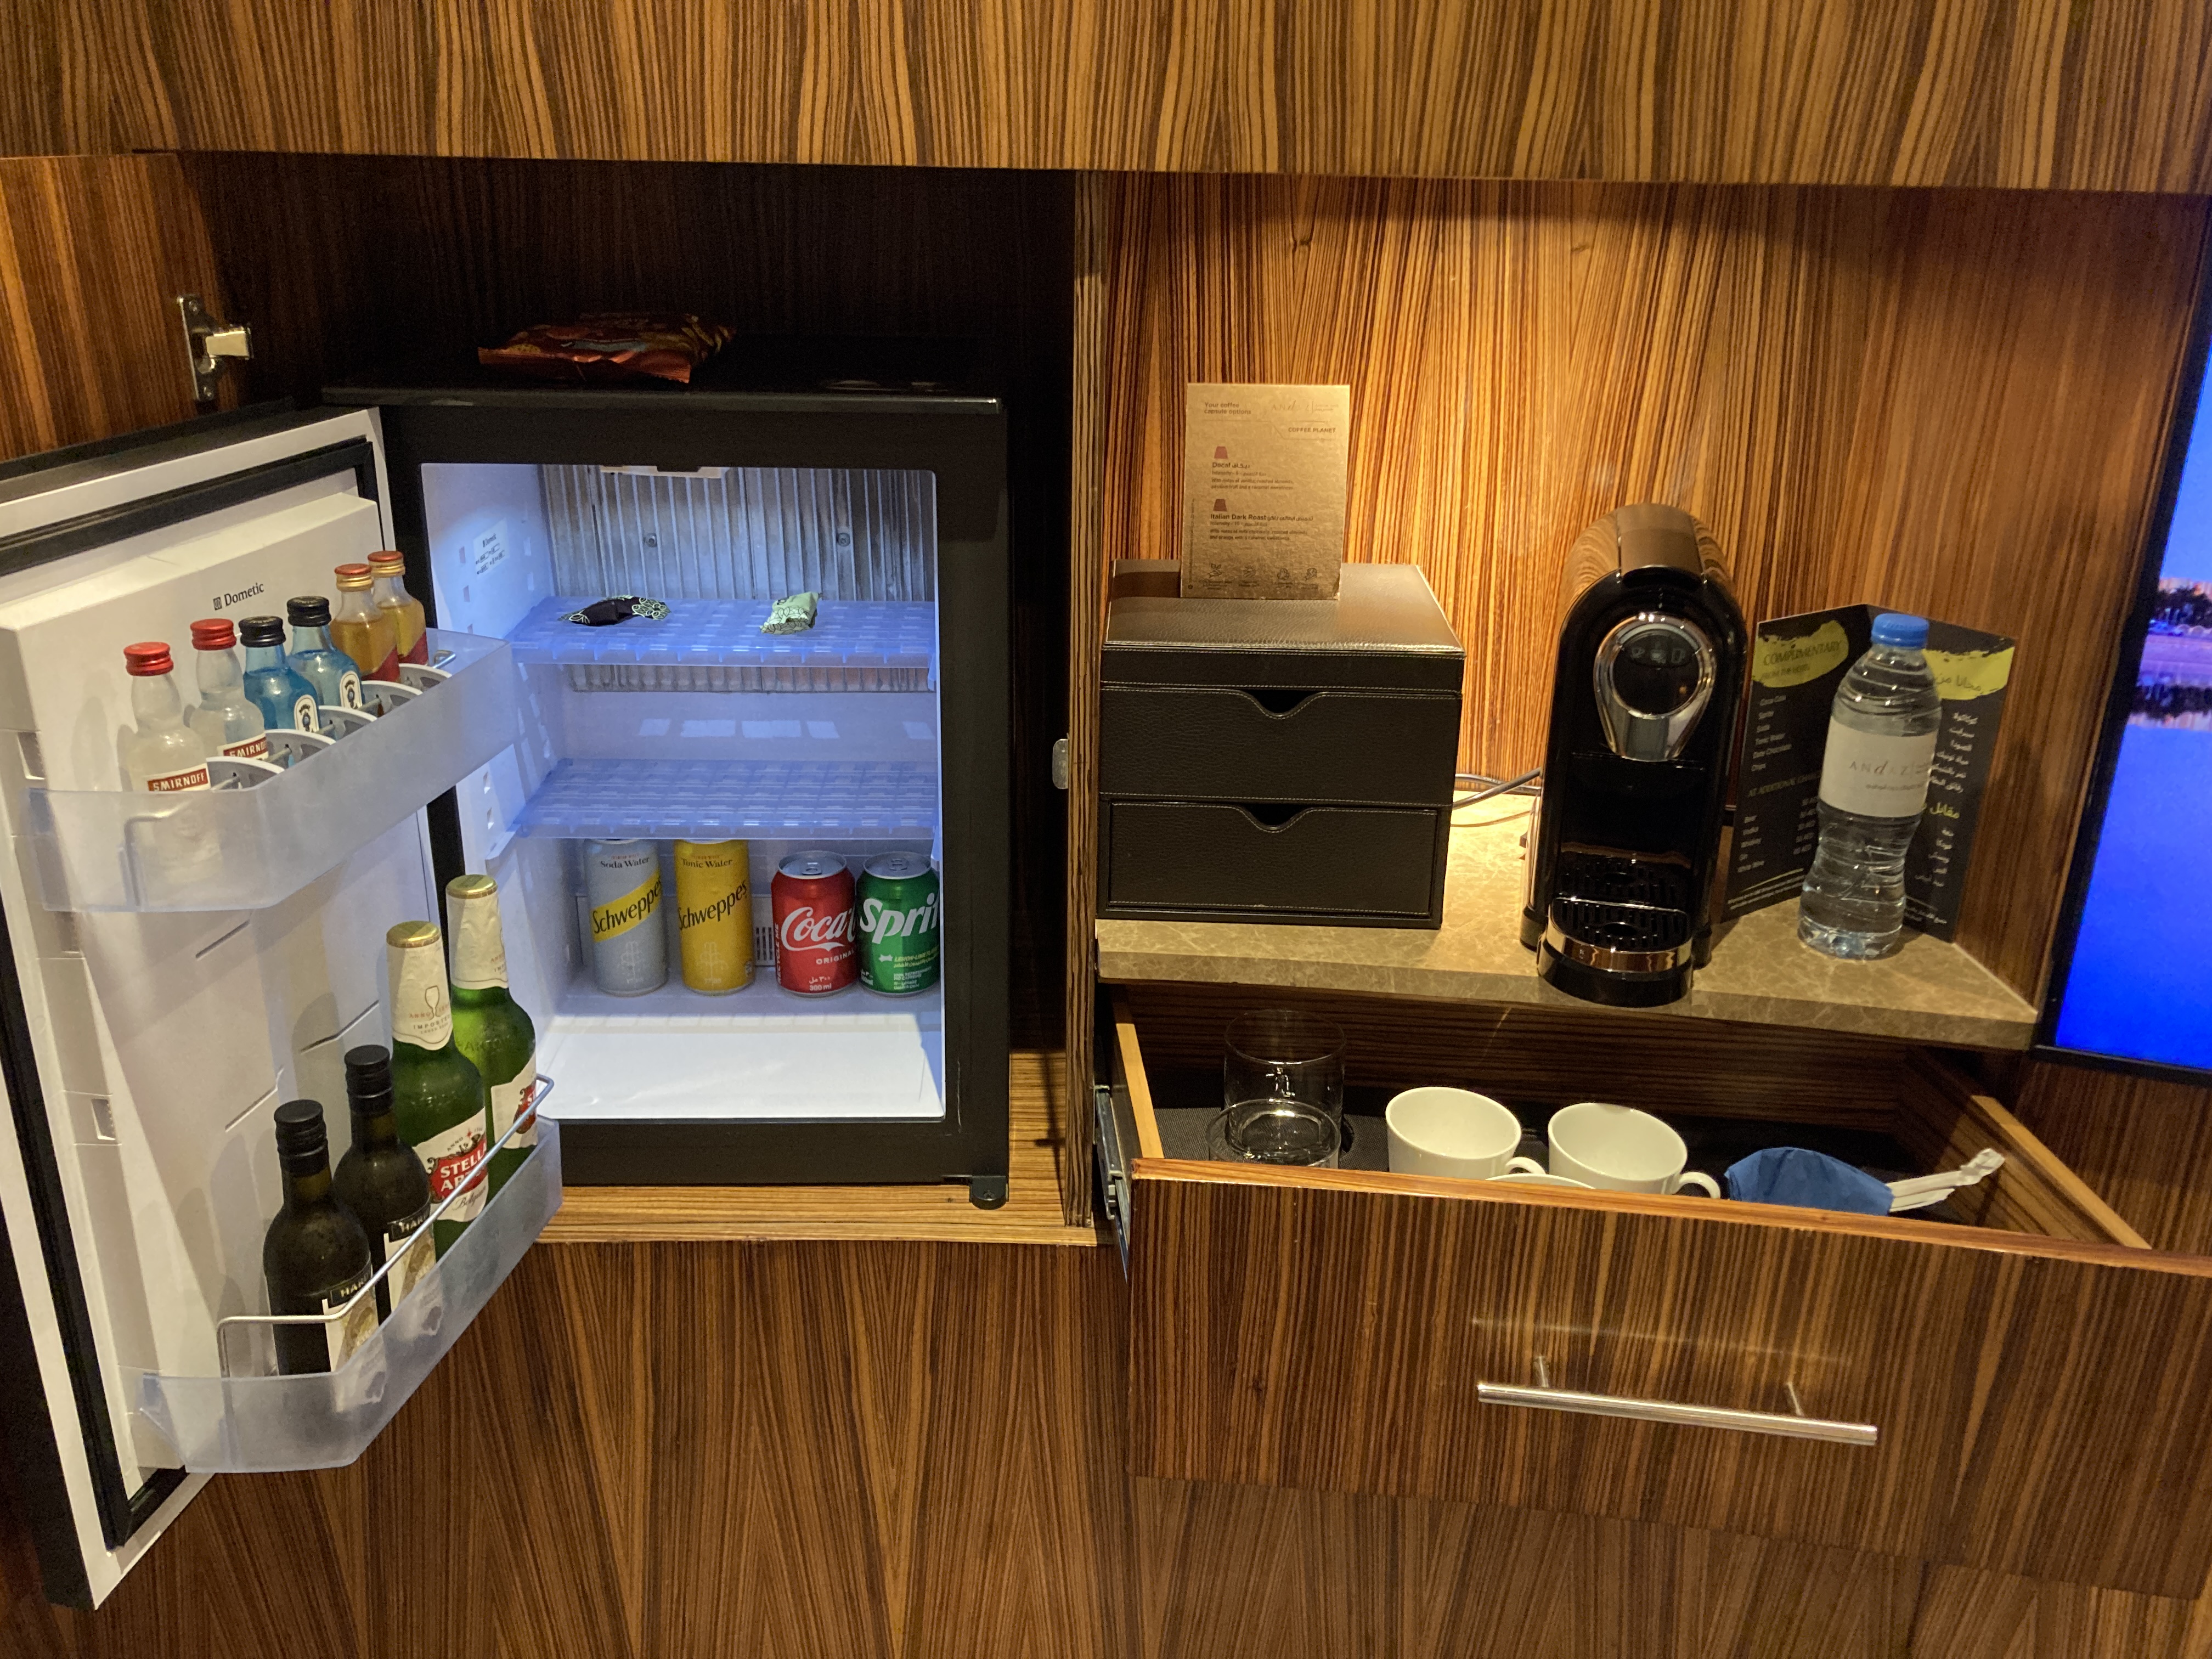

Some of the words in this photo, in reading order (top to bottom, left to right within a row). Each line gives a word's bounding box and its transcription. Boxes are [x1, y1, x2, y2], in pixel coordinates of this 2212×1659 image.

[224, 582, 264, 607] Dometic
[153, 772, 205, 792] SMIRNOFF
[600, 860, 623, 868] Soda
[624, 856, 650, 867] Water
[681, 857, 703, 868] Tonic
[705, 859, 732, 868] Water
[678, 879, 747, 930] Schweppes
[447, 1136, 464, 1152] ANNO
